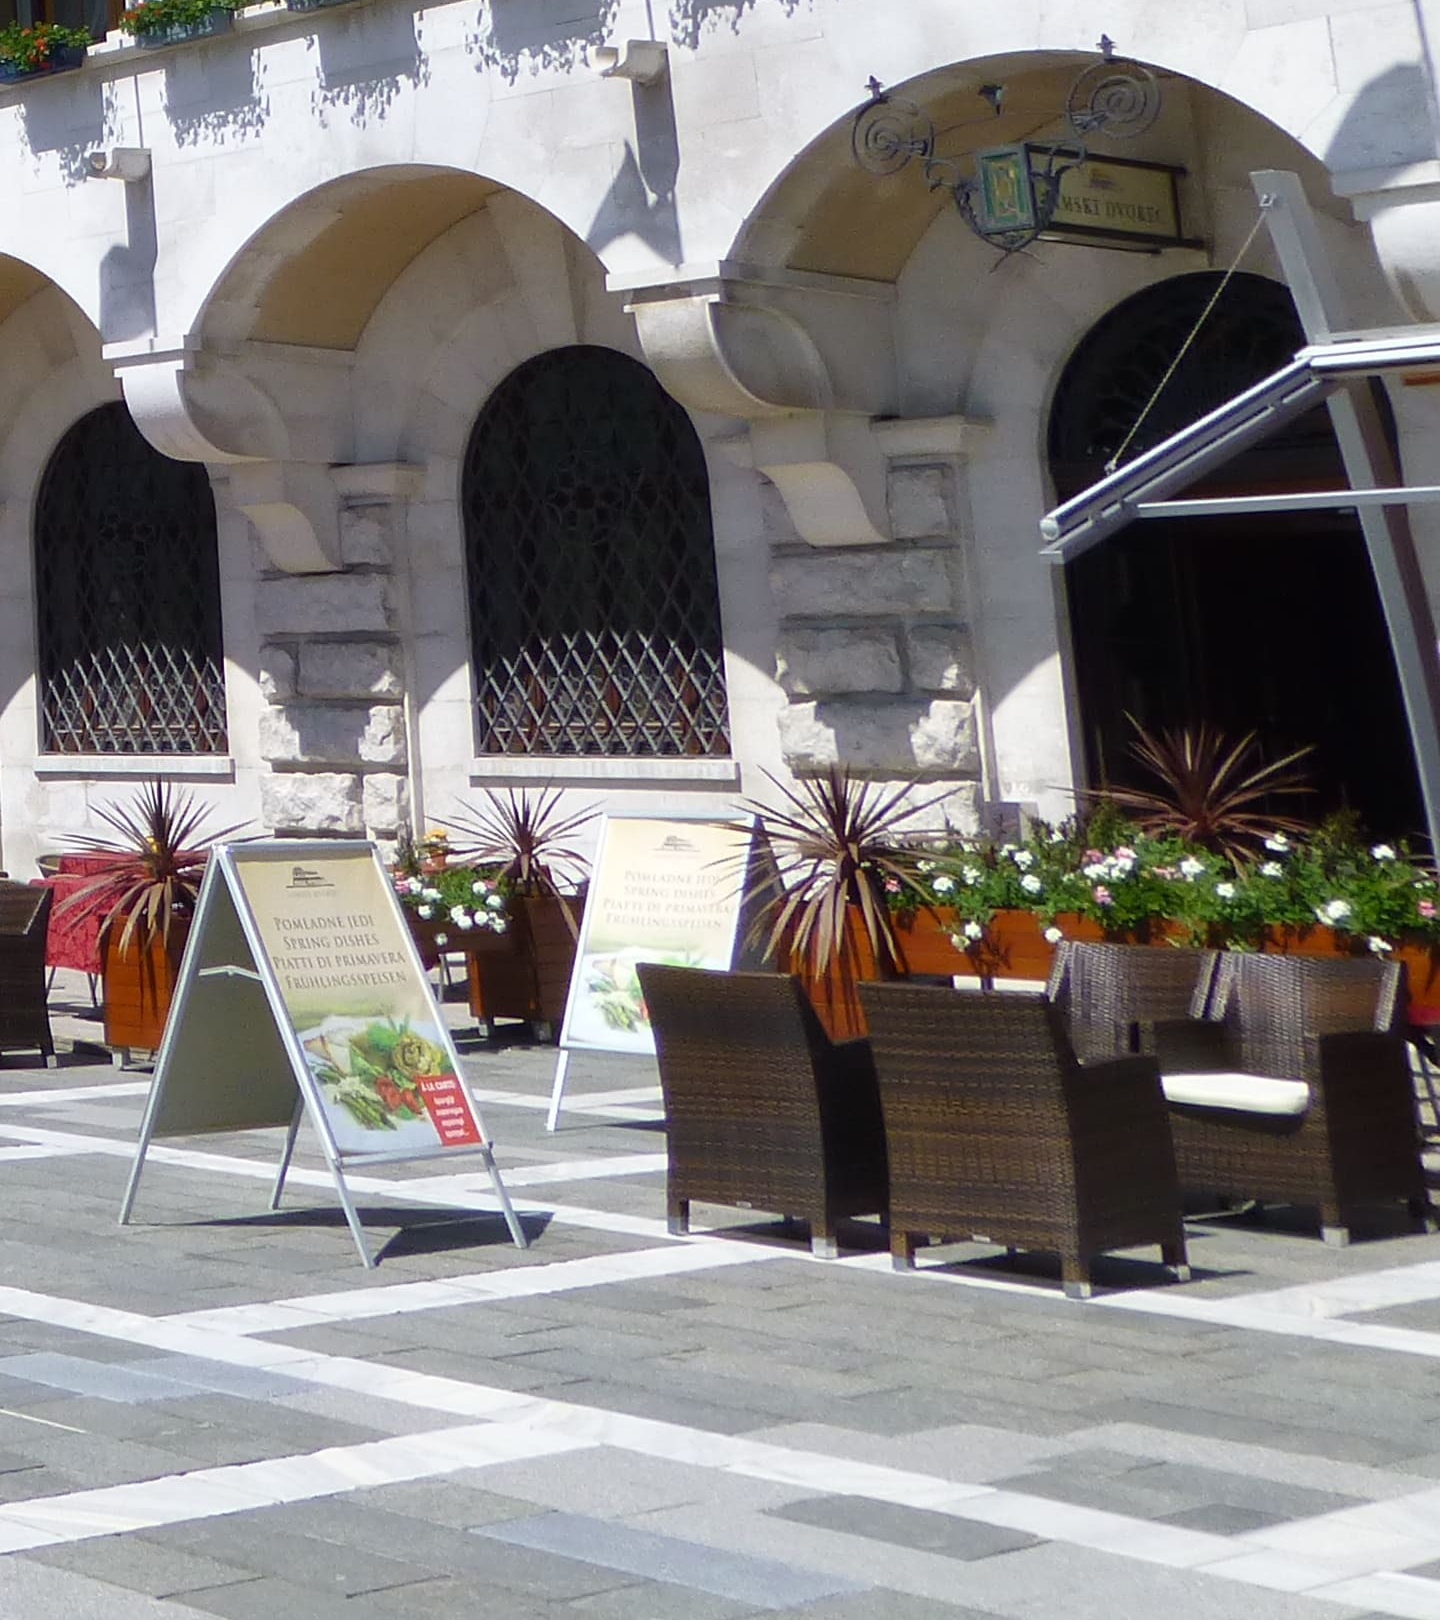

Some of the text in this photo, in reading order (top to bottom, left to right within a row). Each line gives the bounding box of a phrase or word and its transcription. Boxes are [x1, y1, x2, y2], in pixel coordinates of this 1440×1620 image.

[273, 914, 376, 931] POMLADNE JEDI
[283, 933, 380, 951] SPRING DISHES
[272, 951, 407, 970] PIATTI DI PRIMAVERA
